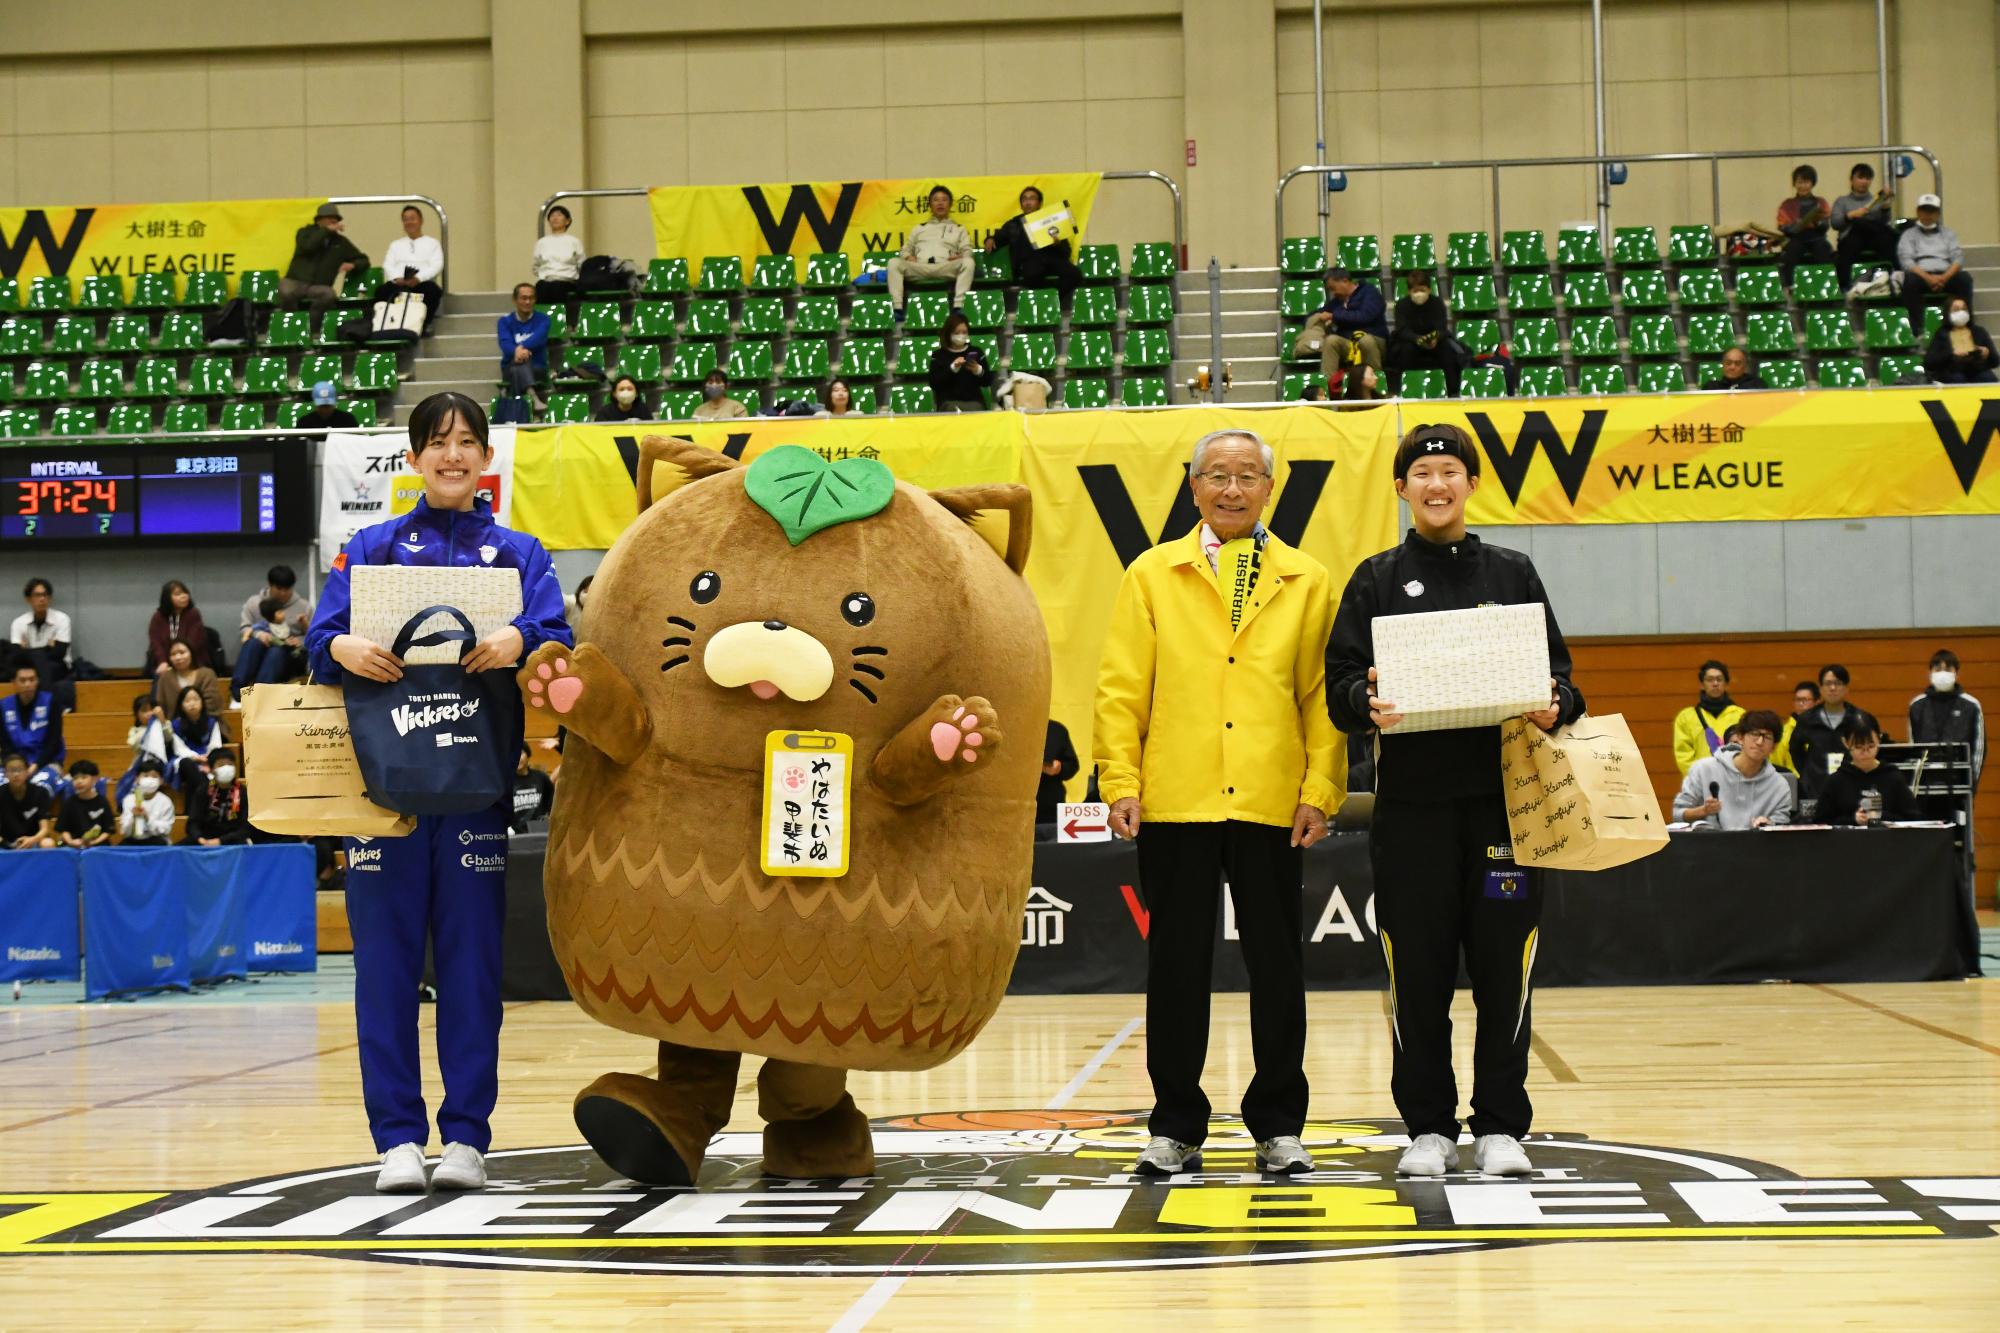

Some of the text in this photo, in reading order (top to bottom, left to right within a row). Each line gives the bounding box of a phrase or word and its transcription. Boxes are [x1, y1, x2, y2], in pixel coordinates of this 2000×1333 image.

[894, 194, 977, 215] 大樹命
[742, 182, 863, 255] W
[125, 219, 207, 239] 大樹生命
[862, 232, 892, 252] W
[90, 253, 236, 277] W LEAGUE
[1647, 422, 1746, 445] 大樹生命
[175, 456, 239, 474] 東京羽田
[1465, 409, 1608, 507] W
[31, 461, 103, 477] INTERVAL
[1607, 462, 1784, 491] W LEAGUE
[18, 480, 116, 515] 37:24
[340, 501, 383, 511] WINNER
[25, 520, 36, 536] 2
[99, 518, 110, 534] 2
[409, 532, 418, 542] 6
[408, 692, 461, 703] TOKYO HANEDA
[391, 702, 461, 737] Vickies
[453, 735, 479, 743] EBARA
[809, 757, 832, 861] やはたいぬ
[1065, 806, 1104, 817] POSS.
[349, 846, 381, 869] Vickies
